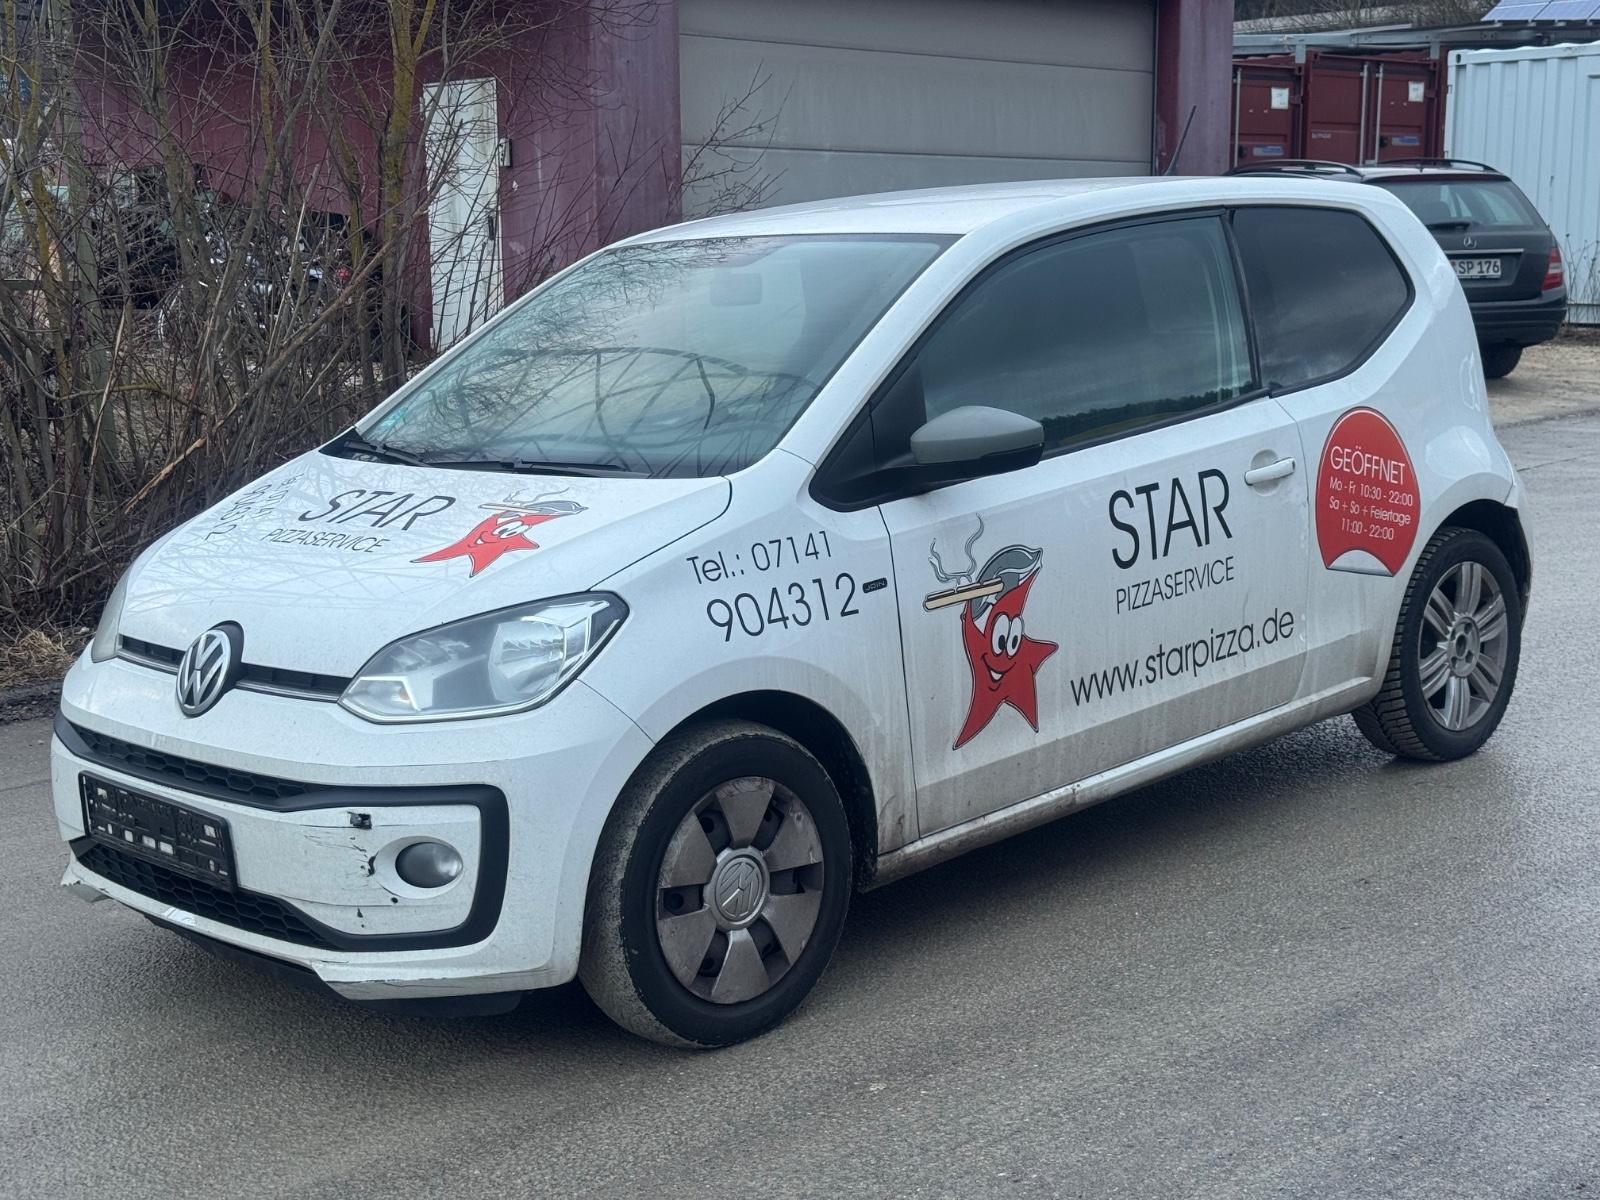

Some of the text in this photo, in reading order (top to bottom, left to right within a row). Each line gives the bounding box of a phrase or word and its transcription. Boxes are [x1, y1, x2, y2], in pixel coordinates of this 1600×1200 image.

[1458, 260, 1500, 275] SP 176
[1330, 445, 1406, 486] GEÖFFNET
[298, 489, 457, 532] STAR
[1329, 476, 1343, 491] Mo
[1348, 481, 1357, 495] Fr
[1360, 483, 1382, 500] 10:30
[1388, 490, 1413, 507] 22:00
[1329, 496, 1340, 510] Sa
[1350, 501, 1360, 515] So
[1370, 505, 1411, 526] Feiertage
[1108, 468, 1233, 570] STAR
[1341, 518, 1363, 535] 11:00
[1369, 524, 1394, 541] 22:00
[260, 528, 391, 554] PIZZASERVICE
[686, 530, 832, 585] Tel.: 07141
[1116, 555, 1235, 615] PIZZASERVICE
[706, 572, 860, 642] 904312
[1070, 607, 1295, 707] www.starpizza.de
